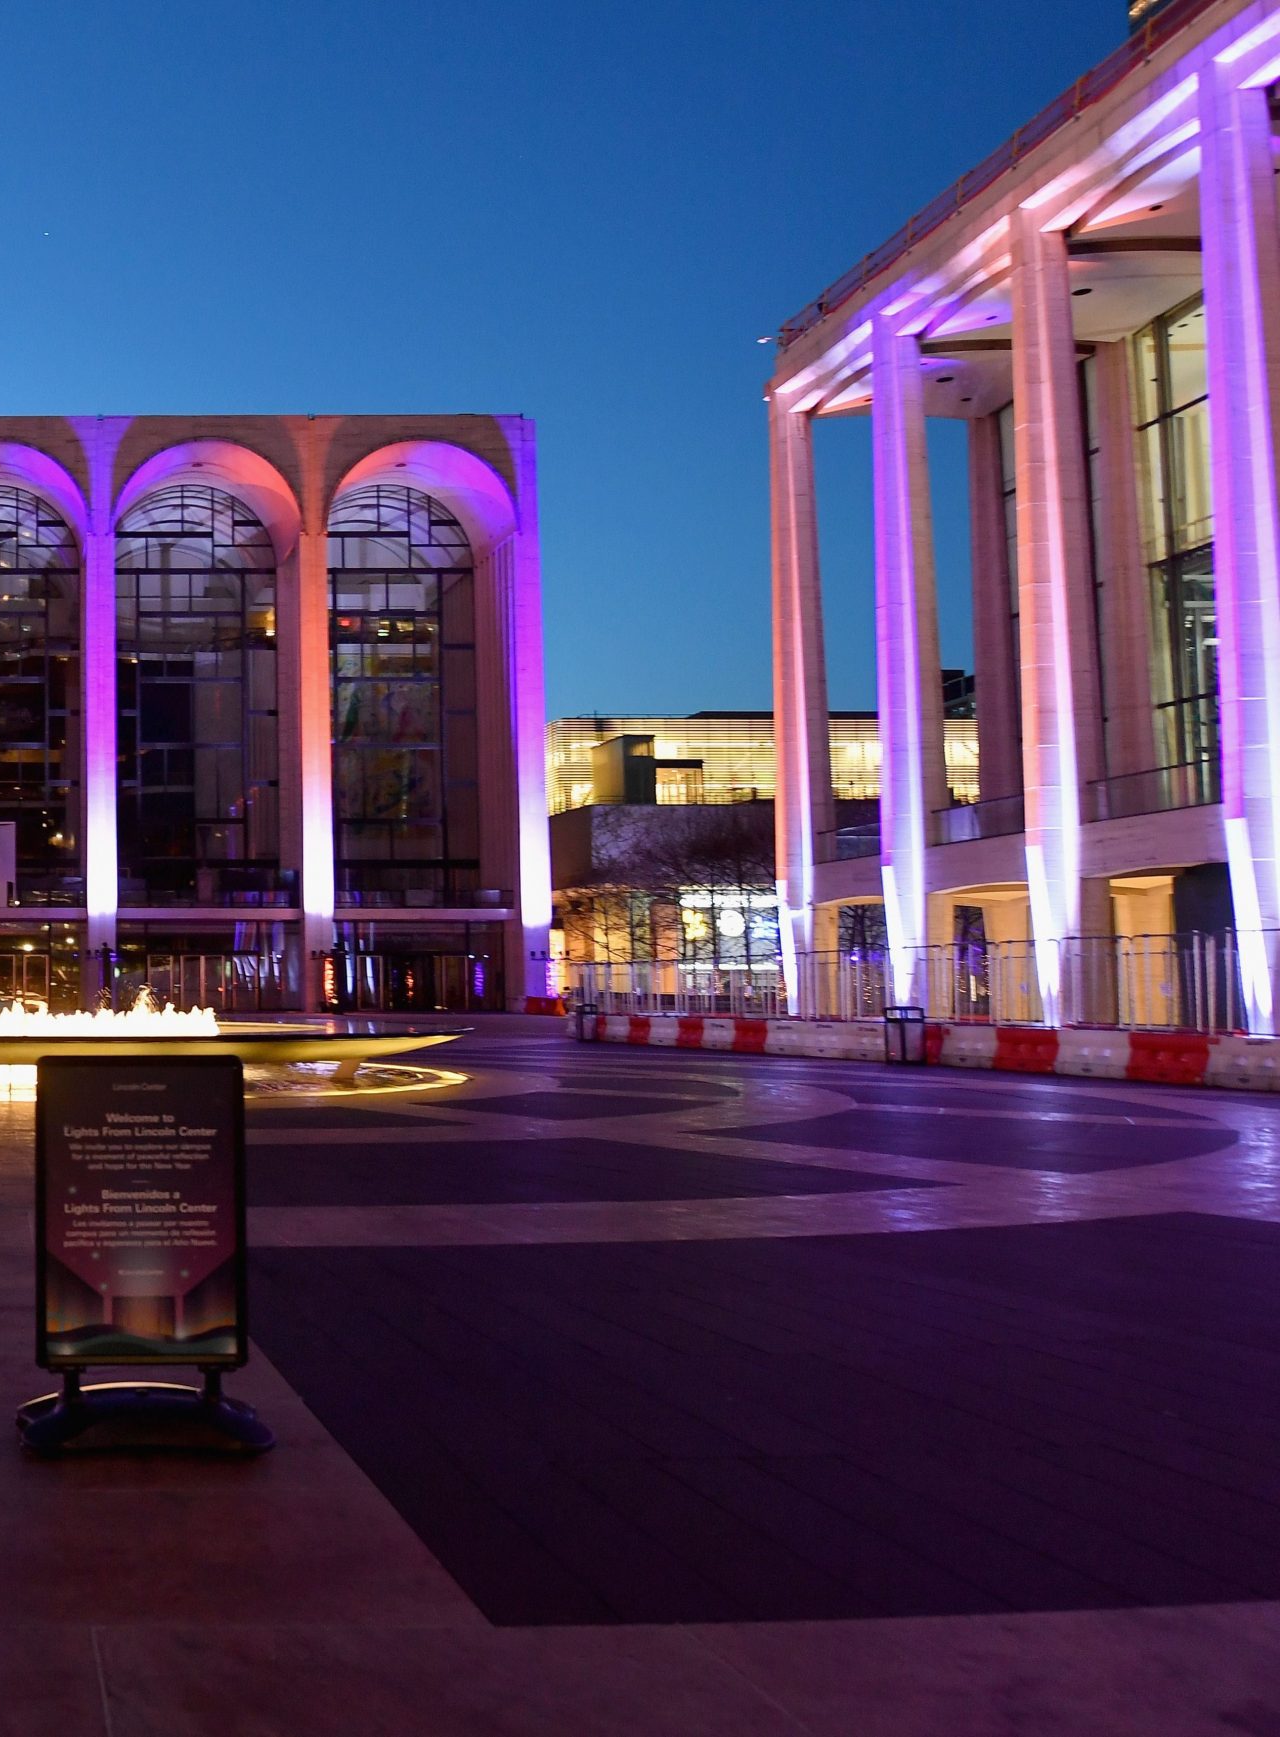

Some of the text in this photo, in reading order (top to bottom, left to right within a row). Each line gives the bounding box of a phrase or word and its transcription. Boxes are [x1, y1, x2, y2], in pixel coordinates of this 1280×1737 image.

[112, 1082, 166, 1091] Lincoln Center
[105, 1113, 175, 1123] Welcome to
[64, 1126, 217, 1139] Lights From Lincoln Center
[101, 1189, 170, 1199] Bienvenidos
[64, 1203, 217, 1215] Lights From Lincoln Center
